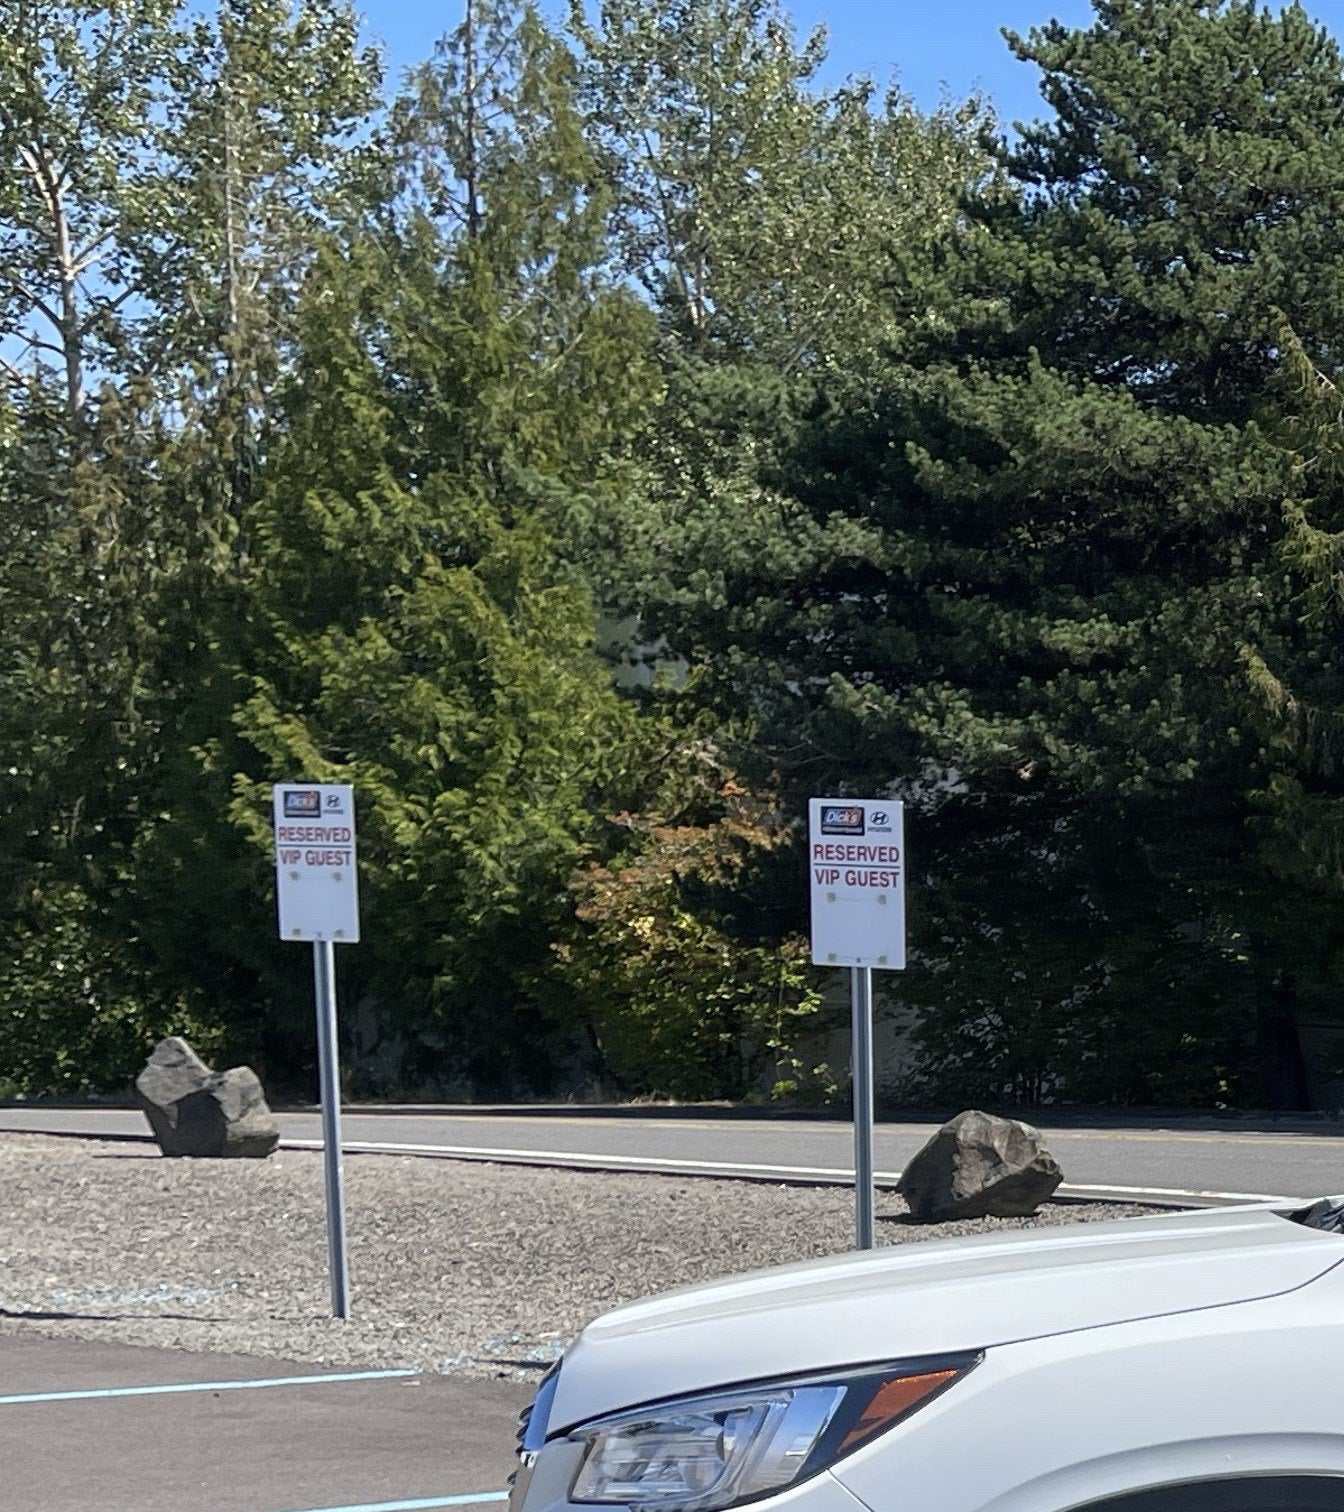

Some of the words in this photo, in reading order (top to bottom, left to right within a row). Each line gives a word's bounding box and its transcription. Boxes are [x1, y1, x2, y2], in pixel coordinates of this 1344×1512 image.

[278, 826, 352, 843] RESERVED
[280, 851, 301, 864] VIP
[305, 850, 352, 866] GUEST
[813, 844, 900, 863] RESERVED
[815, 868, 840, 885] VIP
[845, 870, 899, 888] GUEST
